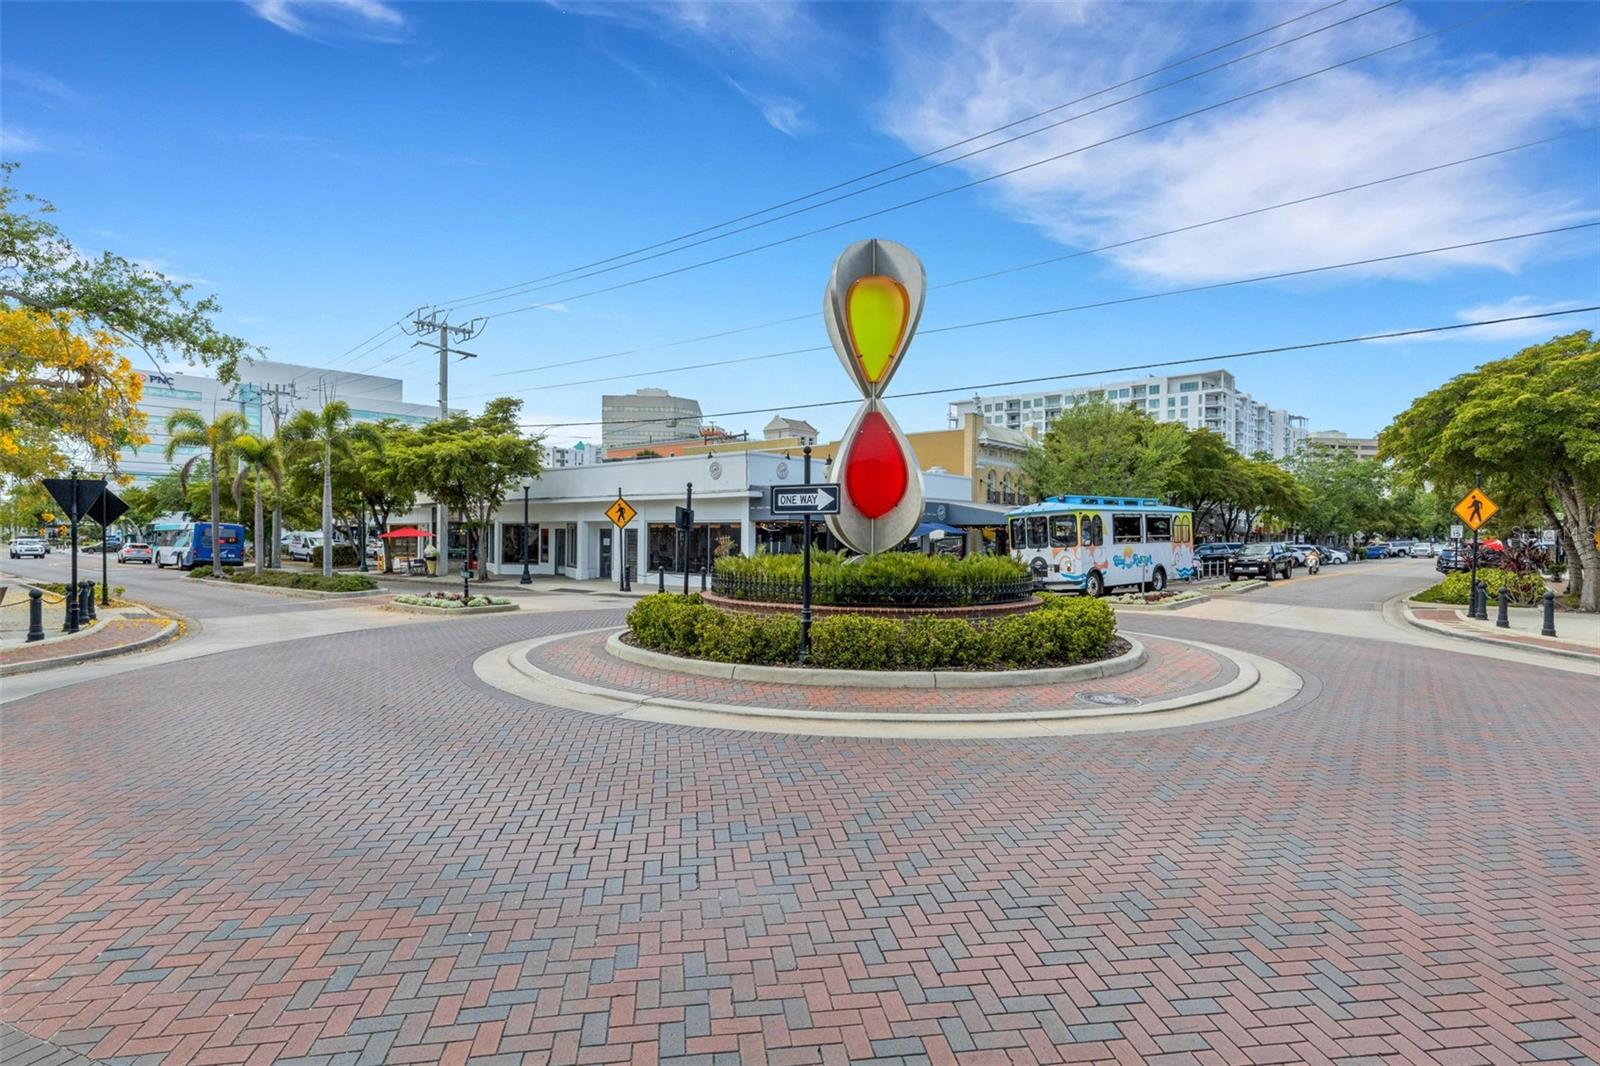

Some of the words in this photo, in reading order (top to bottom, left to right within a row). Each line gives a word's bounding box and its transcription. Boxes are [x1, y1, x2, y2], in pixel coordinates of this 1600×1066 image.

[149, 375, 175, 386] PNC
[780, 495, 797, 505] ONE
[800, 494, 818, 505] WAY
